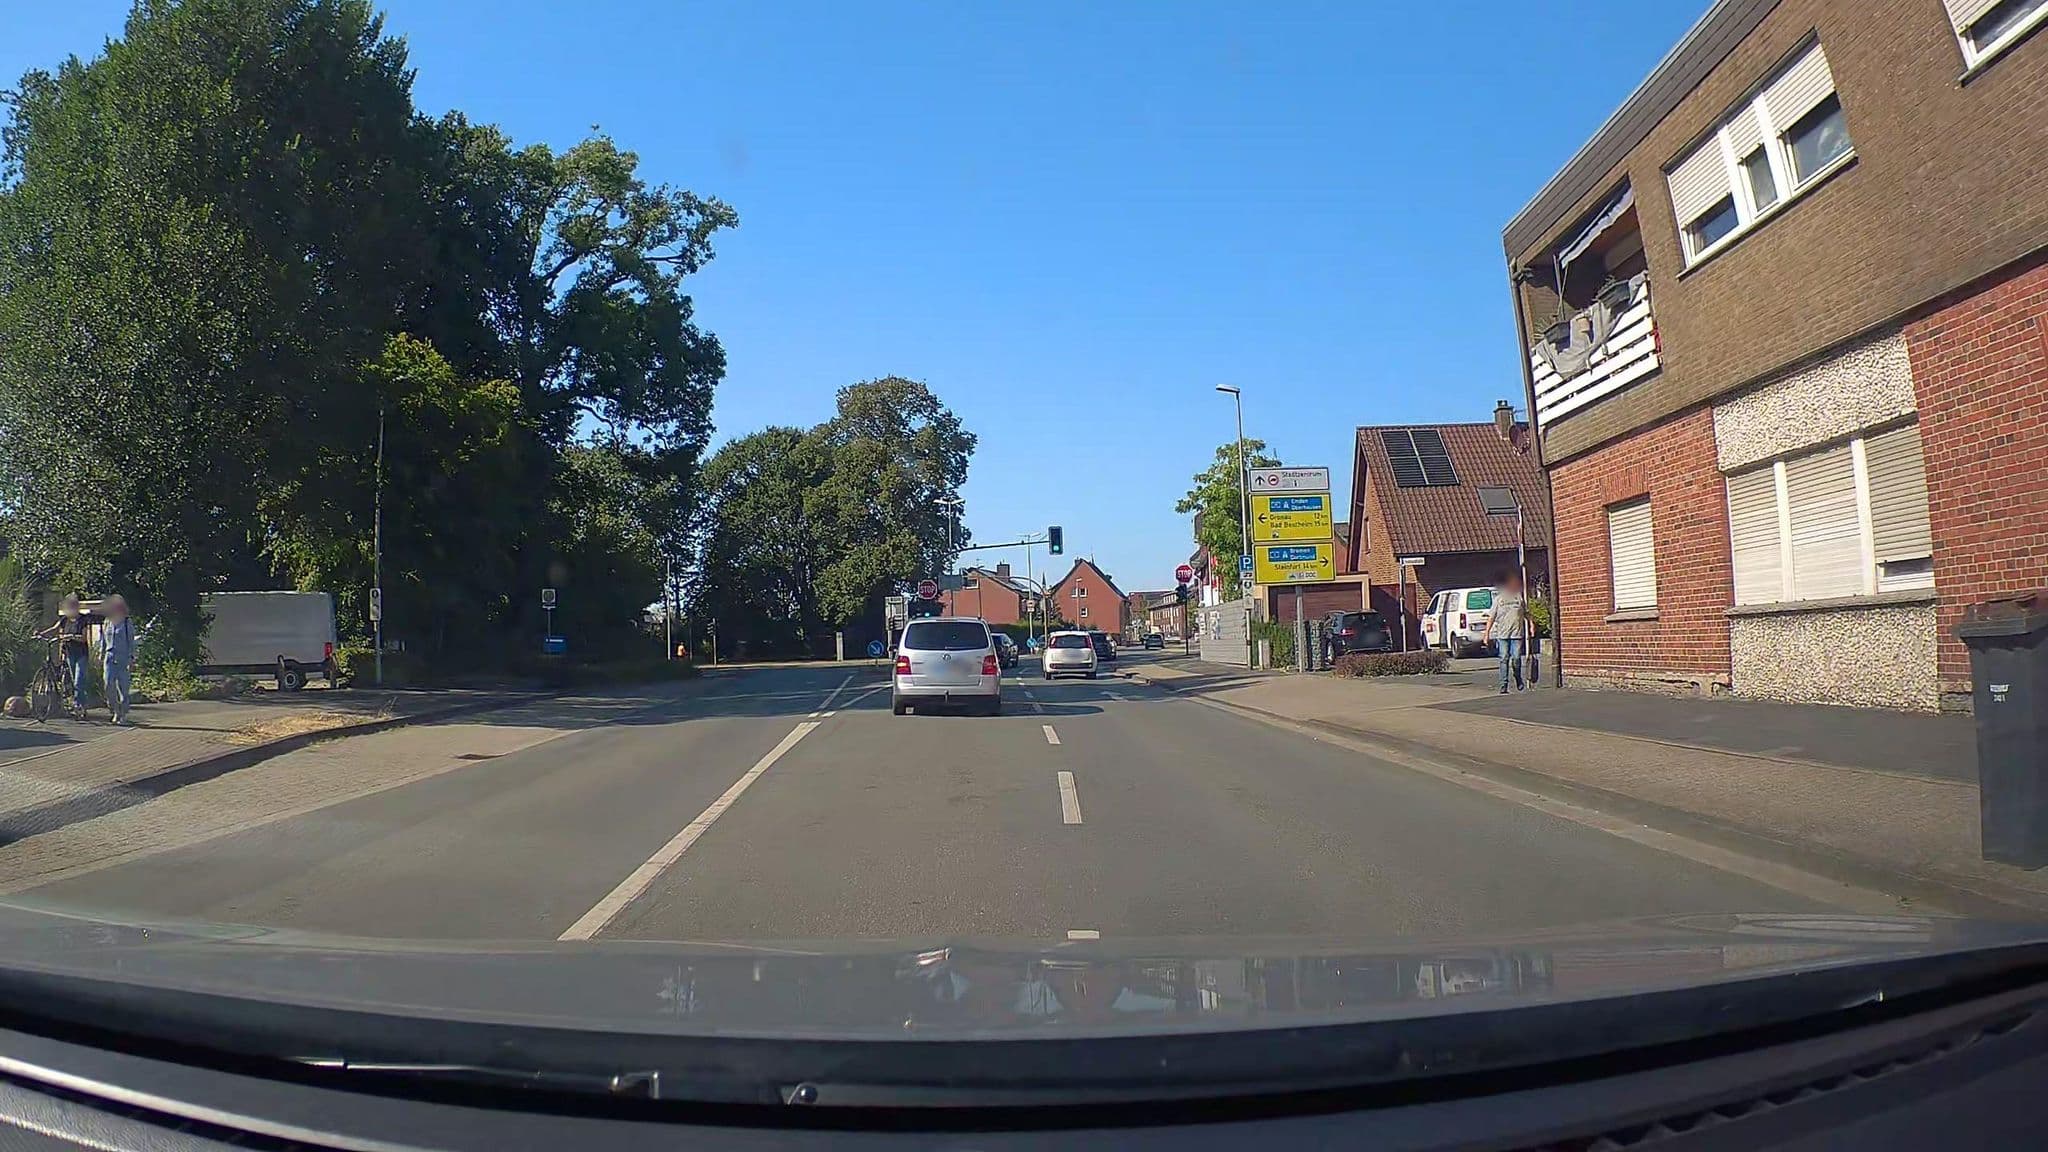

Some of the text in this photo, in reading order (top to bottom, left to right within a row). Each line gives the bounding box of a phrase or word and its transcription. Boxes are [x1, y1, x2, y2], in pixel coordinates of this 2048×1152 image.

[1243, 557, 1251, 568] P
[1178, 569, 1192, 579] STOP
[920, 585, 935, 594] STOP
